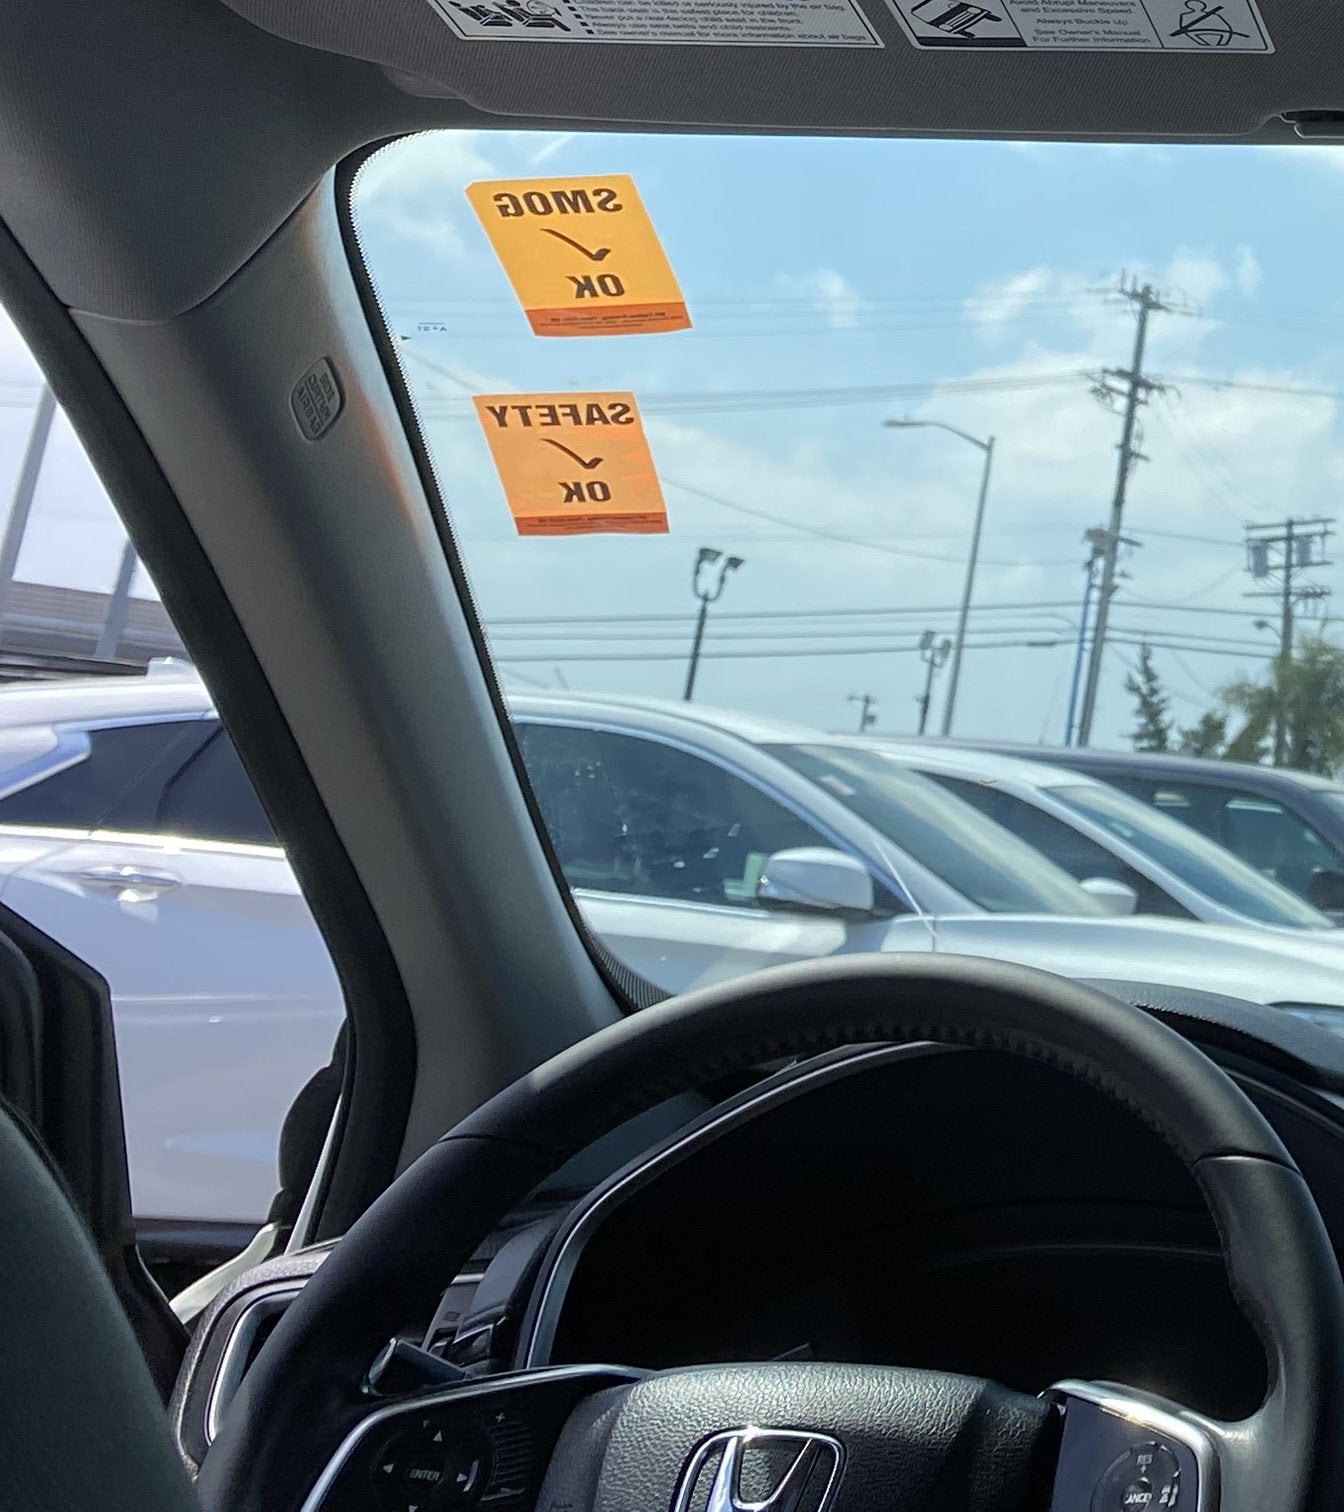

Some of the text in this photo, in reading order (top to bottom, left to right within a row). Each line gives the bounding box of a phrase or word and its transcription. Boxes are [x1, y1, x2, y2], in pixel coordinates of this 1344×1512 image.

[308, 373, 330, 421] CURTAIN
[319, 373, 335, 402] SIDE
[298, 387, 322, 435] AIRBAG
[410, 1468, 440, 1481] ENTER
